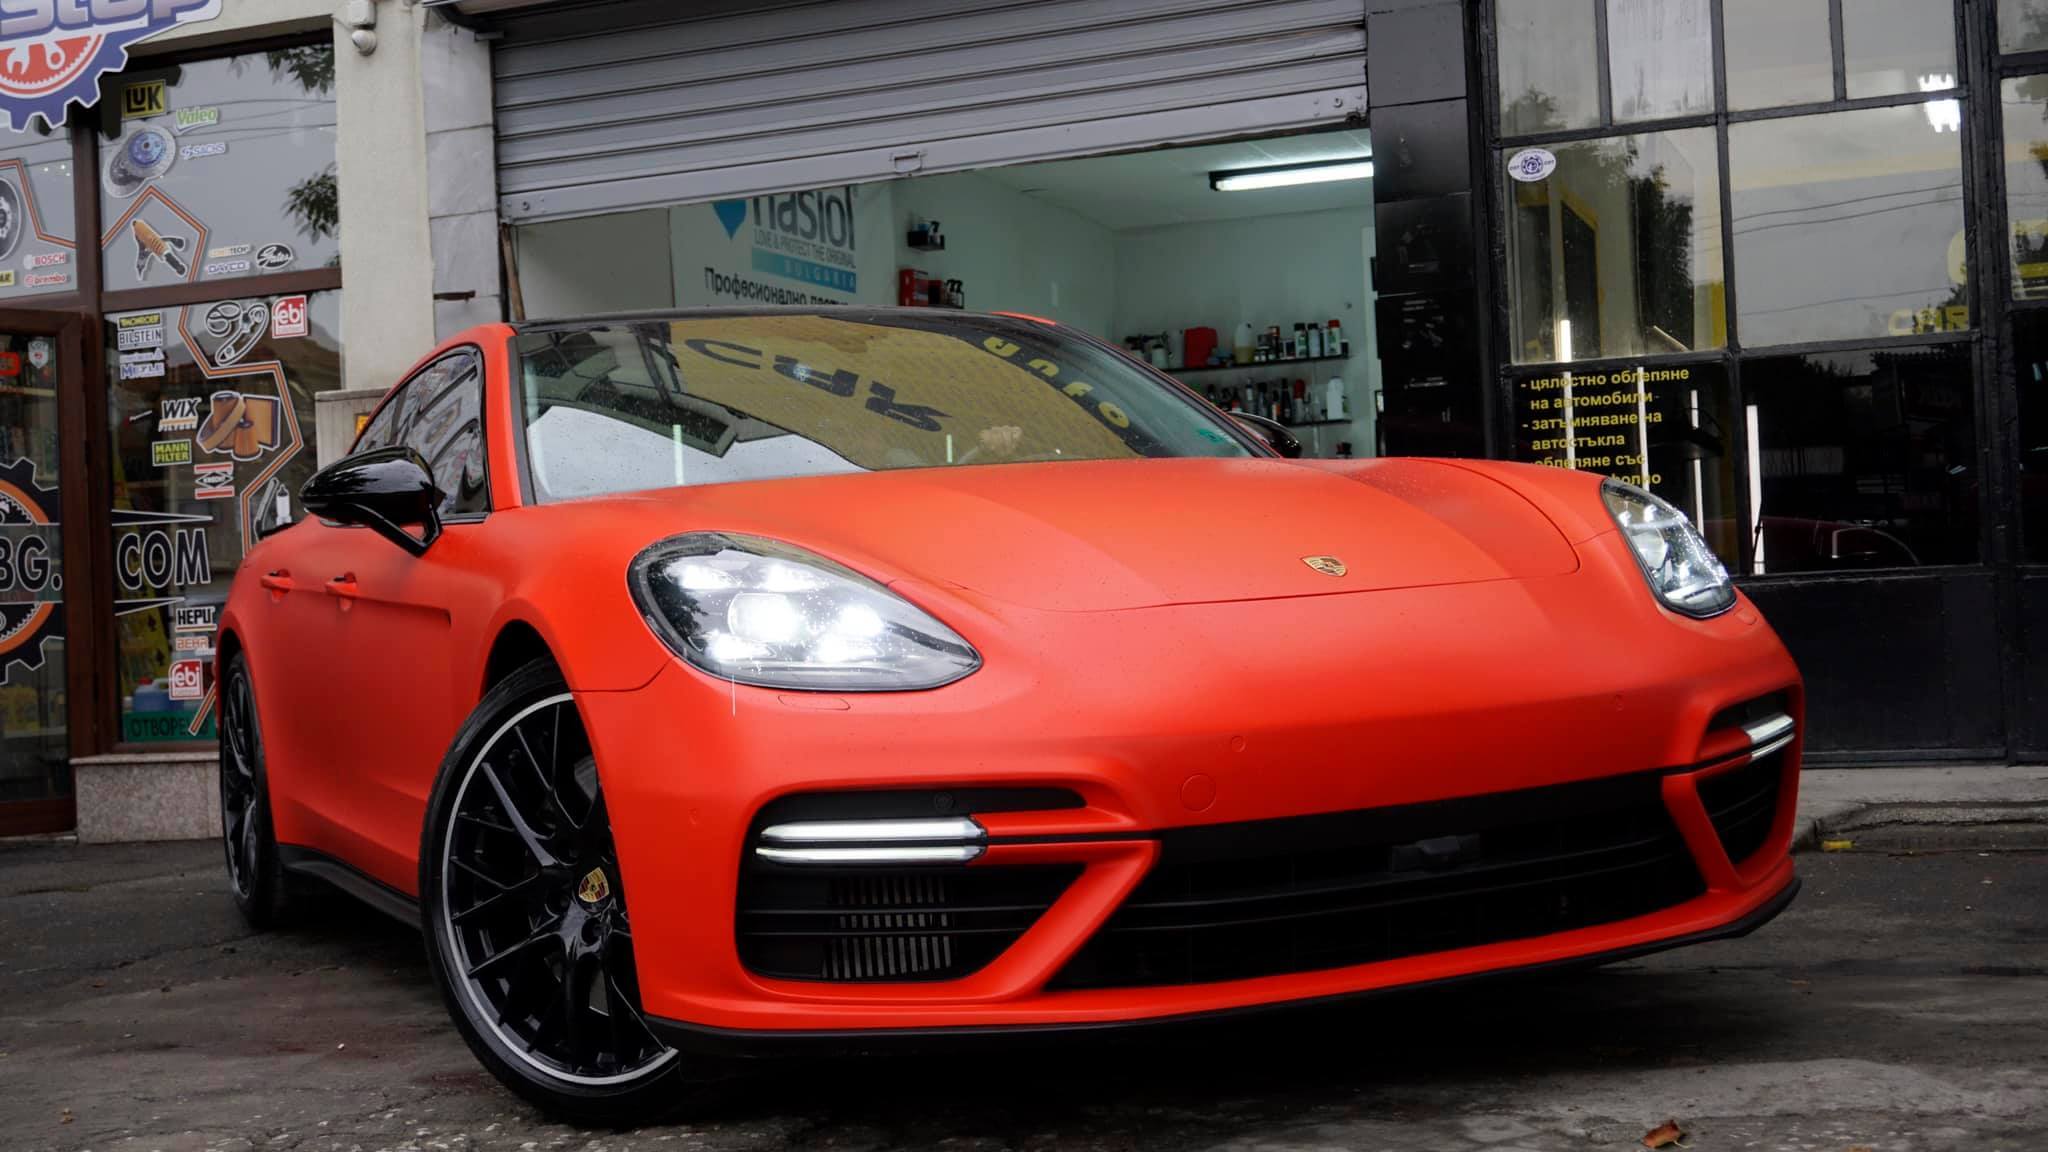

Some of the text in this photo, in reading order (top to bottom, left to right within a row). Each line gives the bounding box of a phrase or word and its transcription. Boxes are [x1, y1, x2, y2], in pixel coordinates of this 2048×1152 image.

[34, 255, 65, 266] BOSCH
[704, 266, 807, 305] Професионално
[273, 301, 304, 325] febi
[120, 329, 161, 345] BILSTEIN
[1530, 374, 1606, 391] цялостно
[1611, 368, 1689, 384] облепяне
[163, 400, 198, 418] WIX
[1530, 391, 1653, 410] на автомобили
[1531, 413, 1638, 431] затъмняване
[1644, 411, 1663, 423] на
[155, 442, 188, 453] MANN
[1532, 435, 1625, 450] автостъкла
[156, 452, 189, 463] FILTER
[117, 528, 211, 590] COM
[178, 609, 212, 625] HEPU
[172, 663, 201, 687] febi
[131, 717, 209, 738] ОТВОРЕ
